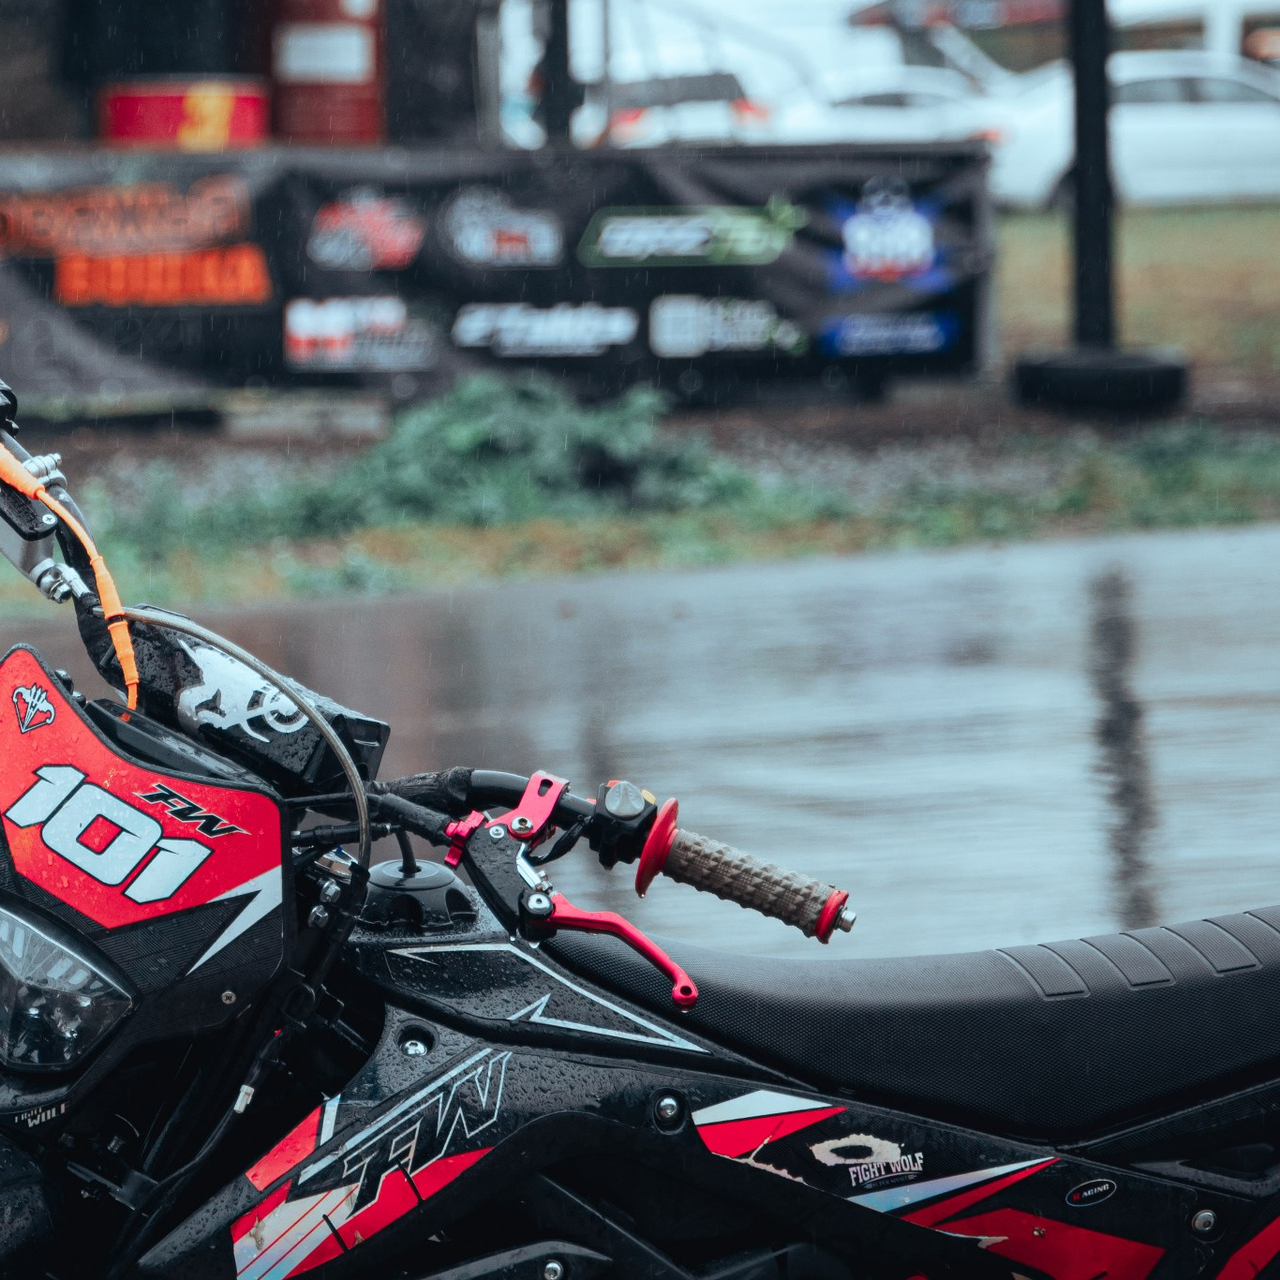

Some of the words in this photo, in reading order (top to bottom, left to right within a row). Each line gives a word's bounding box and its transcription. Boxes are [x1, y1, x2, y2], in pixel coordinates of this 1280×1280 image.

[5, 764, 215, 905] 101
[848, 1162, 887, 1187] FIGHT
[889, 1152, 924, 1173] WOLF
